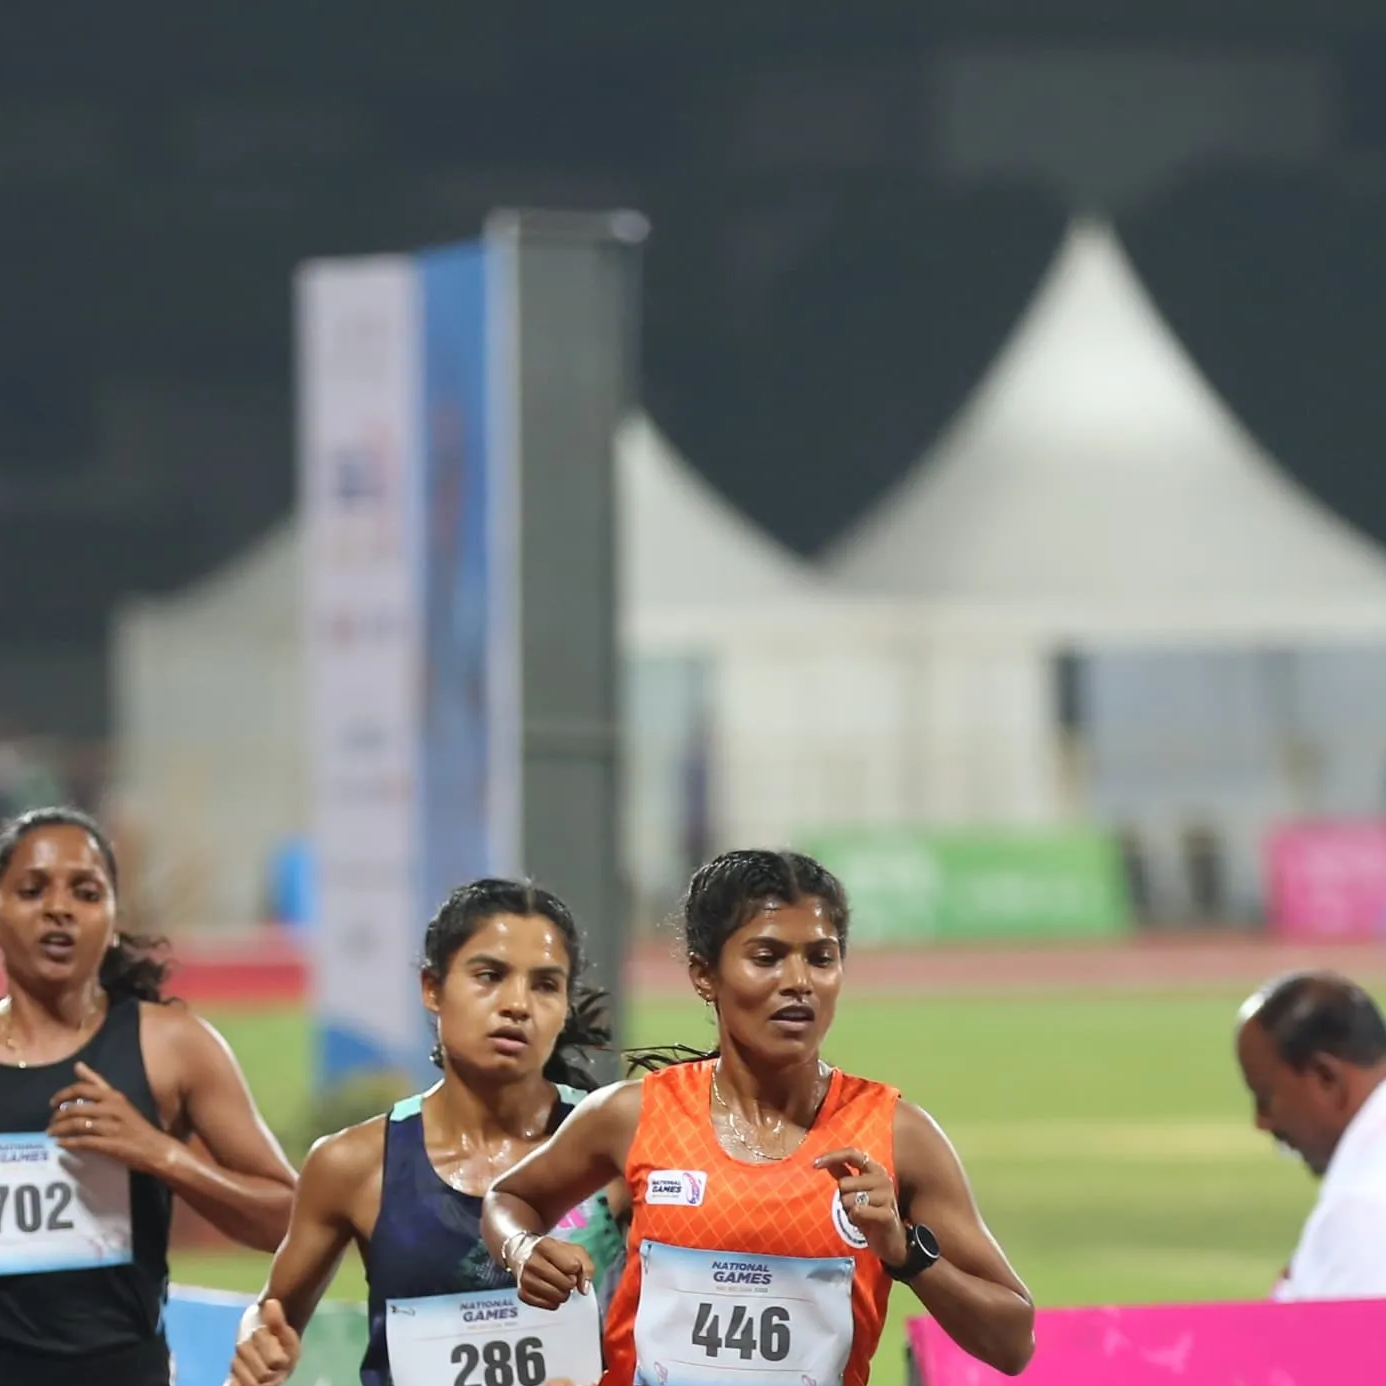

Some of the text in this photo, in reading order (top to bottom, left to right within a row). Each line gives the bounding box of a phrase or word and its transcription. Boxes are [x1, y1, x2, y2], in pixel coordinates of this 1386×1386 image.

[712, 1261, 770, 1273] NATIONAL
[713, 1271, 773, 1285] GAMES
[460, 1299, 514, 1311] NATIONAL
[462, 1307, 518, 1322] GAMES
[692, 1302, 791, 1362] 446
